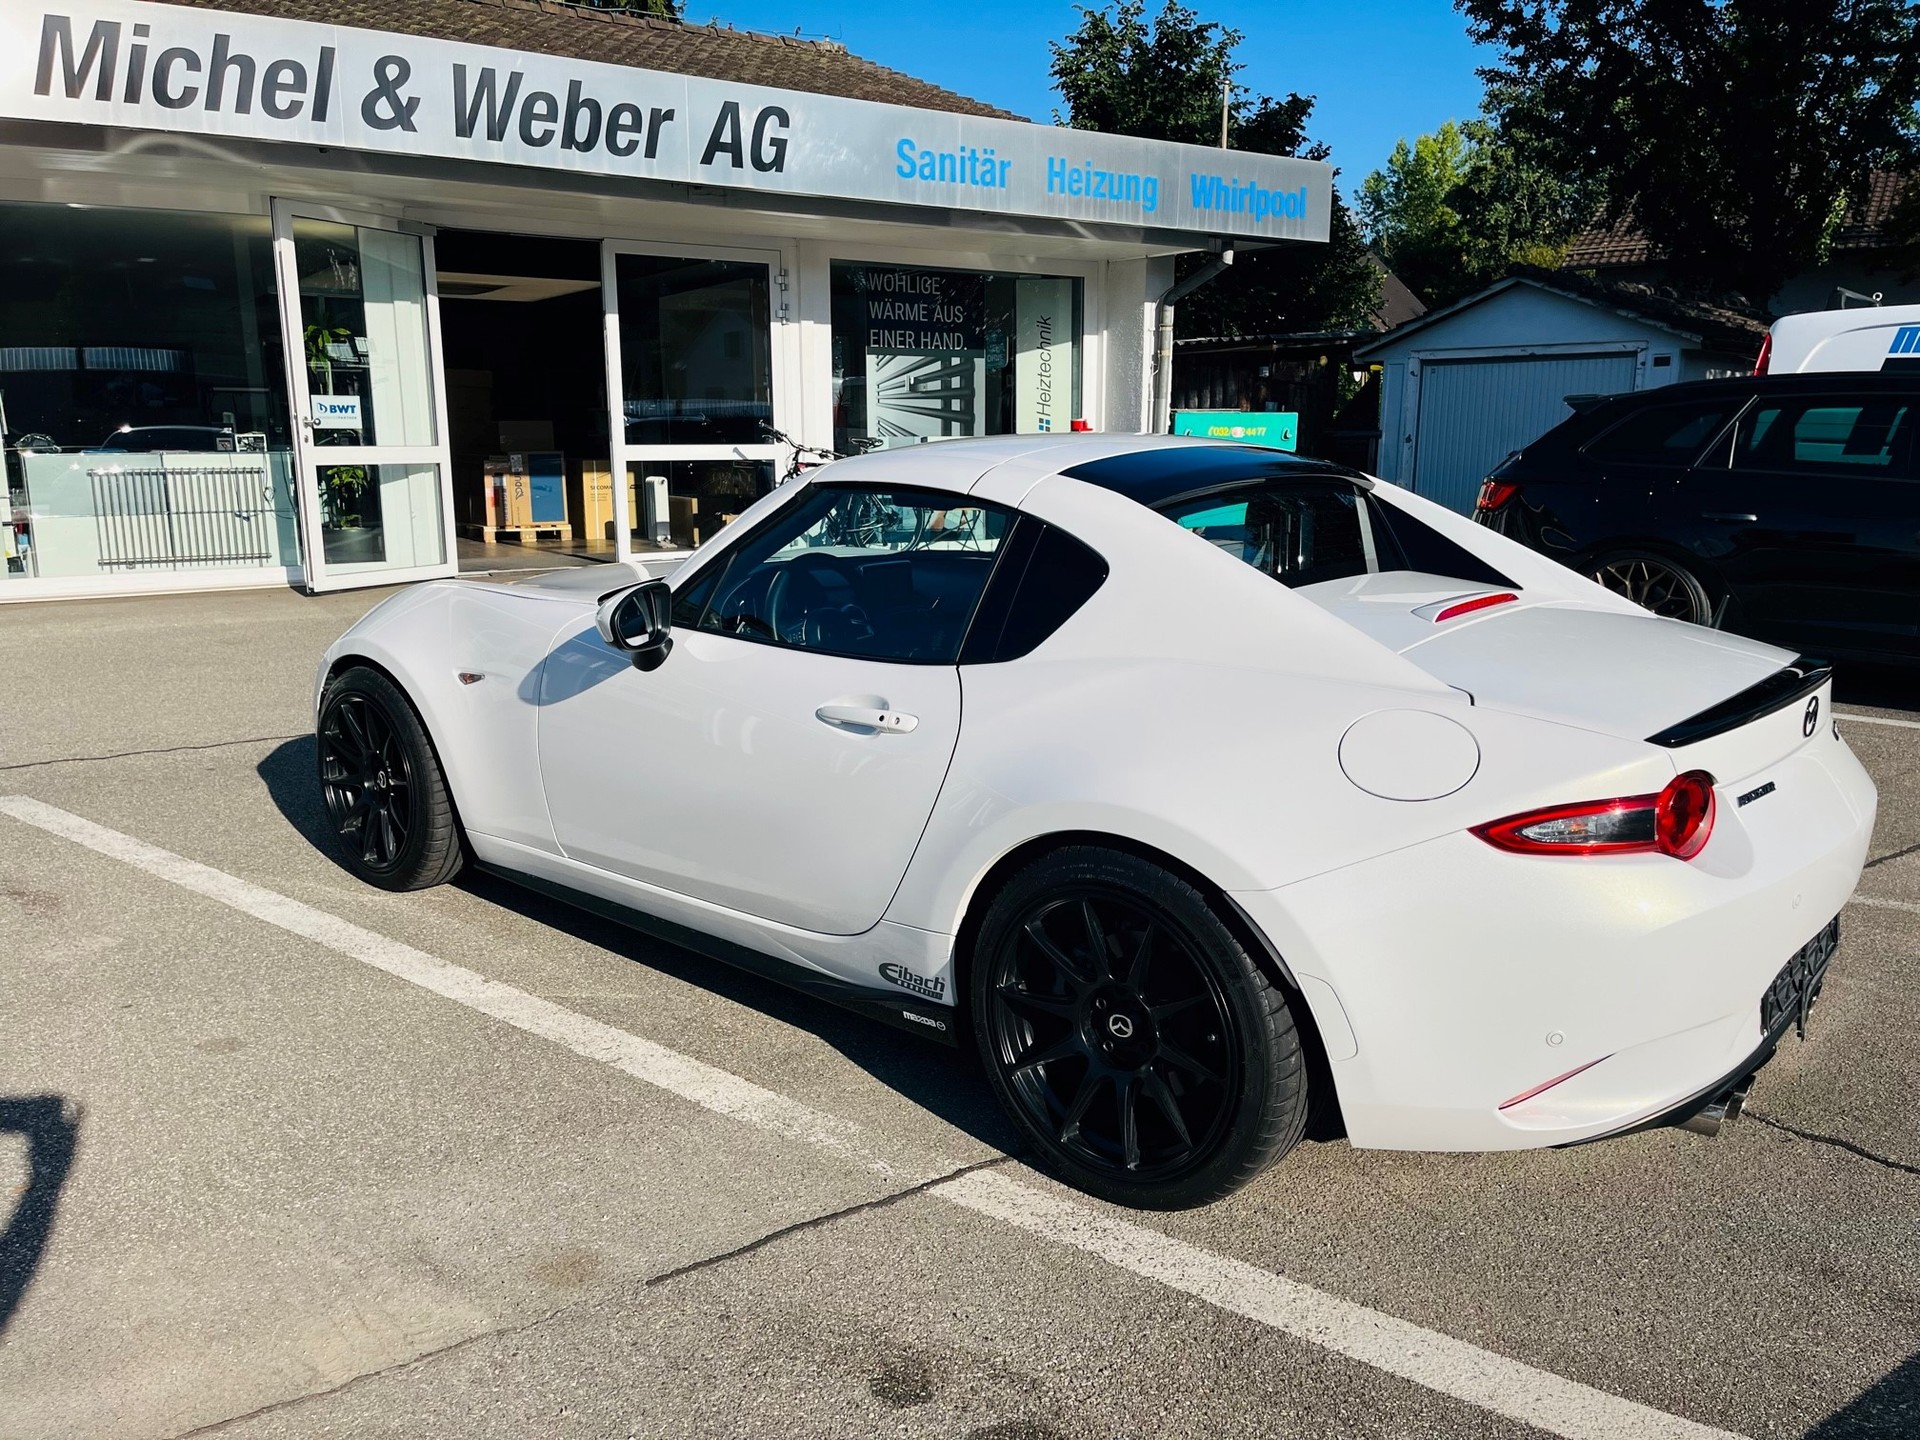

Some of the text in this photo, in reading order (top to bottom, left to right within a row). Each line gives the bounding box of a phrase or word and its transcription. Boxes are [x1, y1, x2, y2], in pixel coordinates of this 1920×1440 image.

[33, 13, 790, 173] Michel & Weber AG
[895, 137, 1308, 222] Sanitär Heizung Whirlpool
[868, 272, 941, 295] WOHLIGE
[868, 298, 964, 323] WÄRME AUS
[869, 329, 916, 349] EINER
[920, 331, 968, 351] HAND.
[1036, 315, 1052, 417] Heiztechnik
[329, 404, 357, 414] BWT
[879, 962, 945, 993] Eibach
[902, 1010, 936, 1027] mazda
